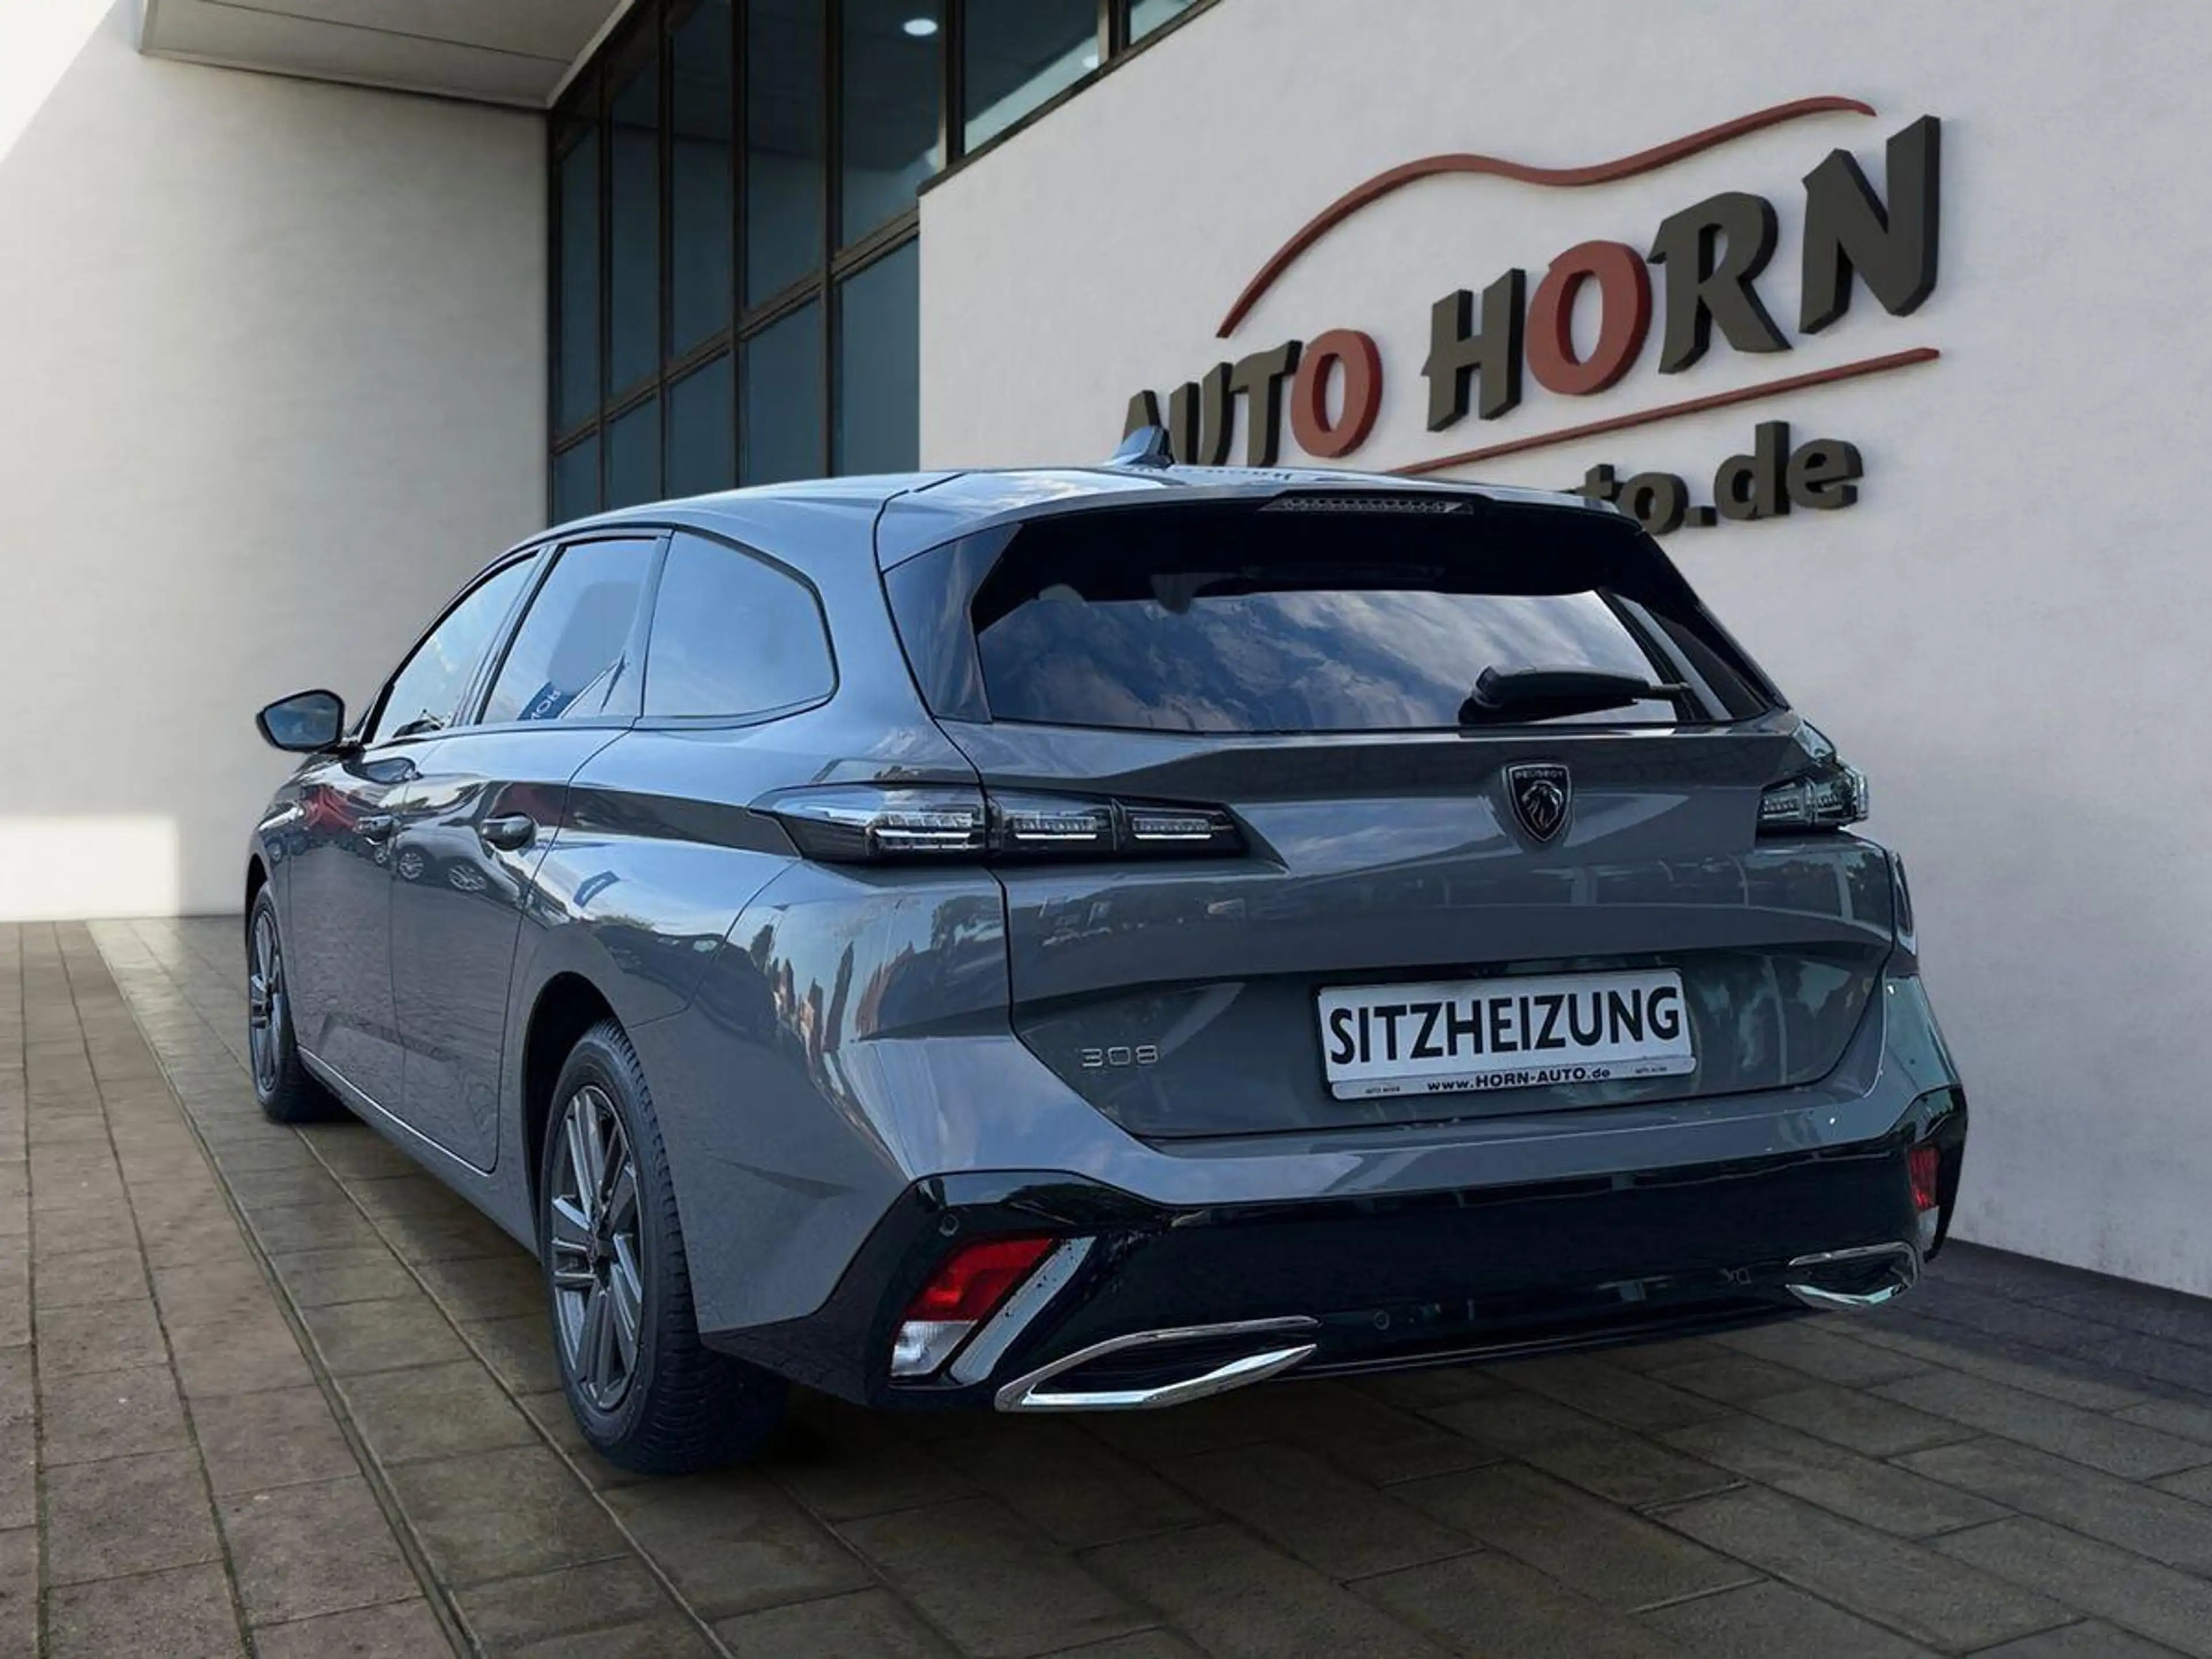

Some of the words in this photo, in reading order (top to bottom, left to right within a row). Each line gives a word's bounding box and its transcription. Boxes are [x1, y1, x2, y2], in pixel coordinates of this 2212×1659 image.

[1421, 115, 1940, 432] HORN
[1331, 986, 1680, 1065] SITZHEIZUNG
[1081, 1045, 1158, 1067] 308
[1427, 1067, 1611, 1090] www.HORN-AUTO.de
